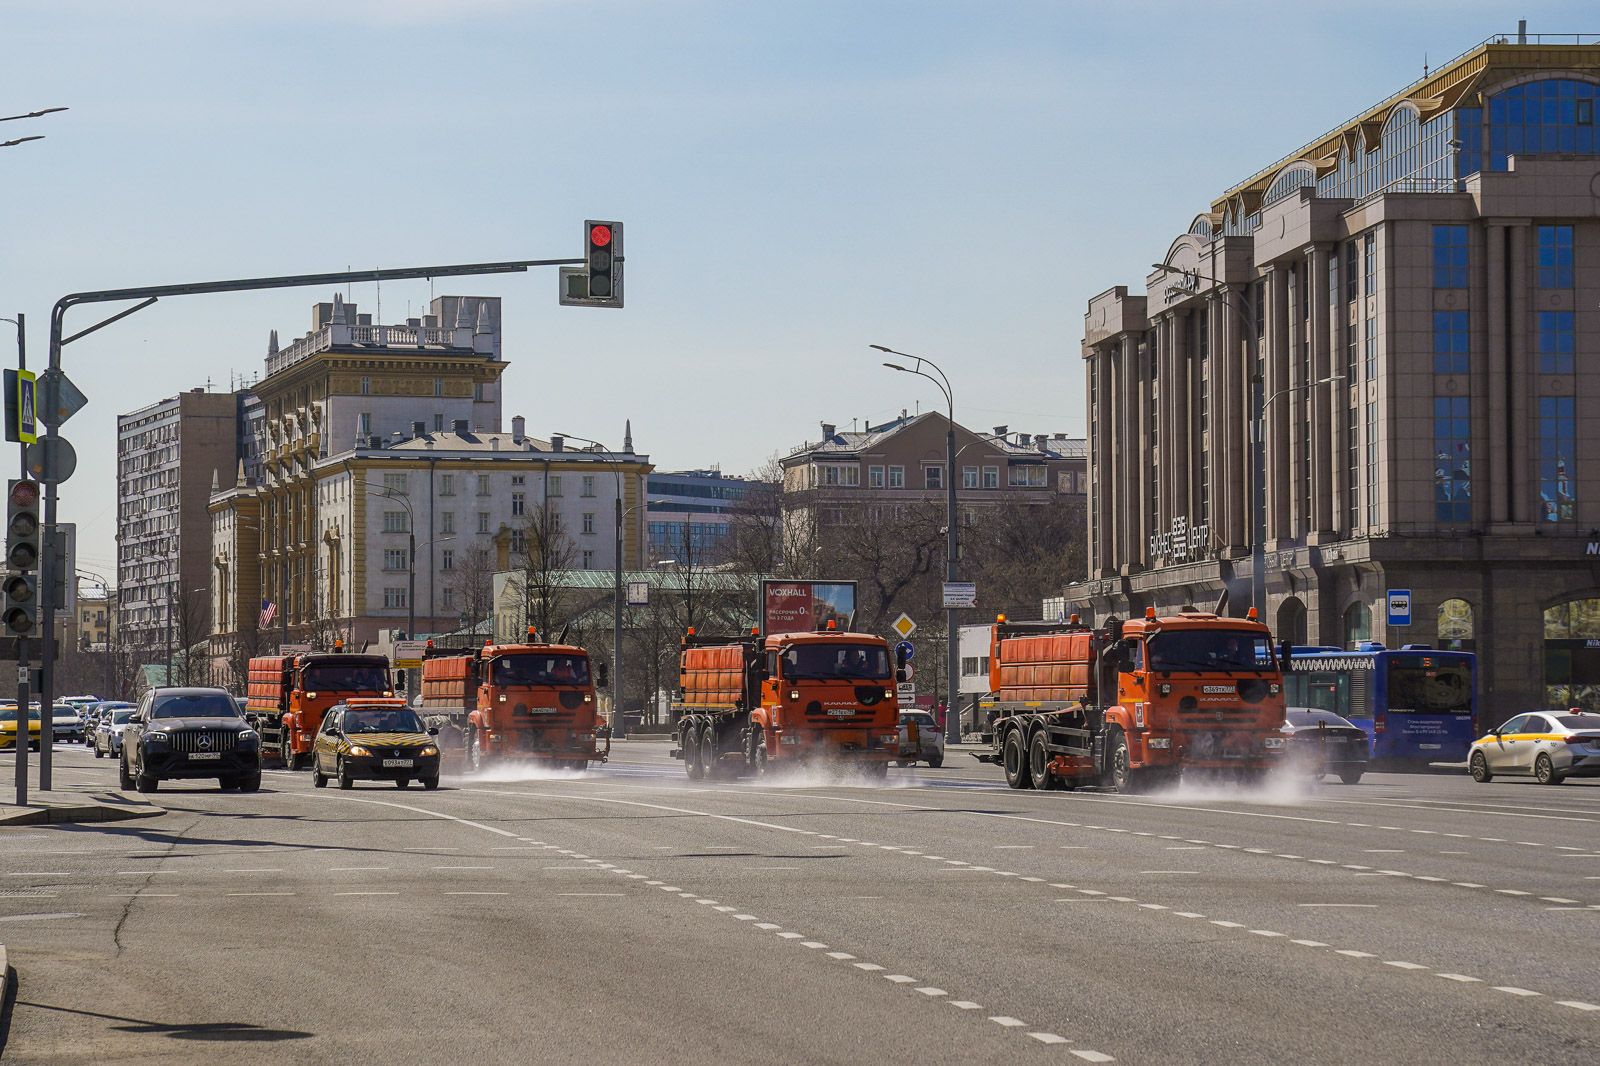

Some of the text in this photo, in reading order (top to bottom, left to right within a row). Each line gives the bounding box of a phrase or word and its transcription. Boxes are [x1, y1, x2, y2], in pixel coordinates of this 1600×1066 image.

[1150, 525, 1208, 556] БИЗНЕС ЦЕНТР
[769, 588, 807, 597] VOXHALL
